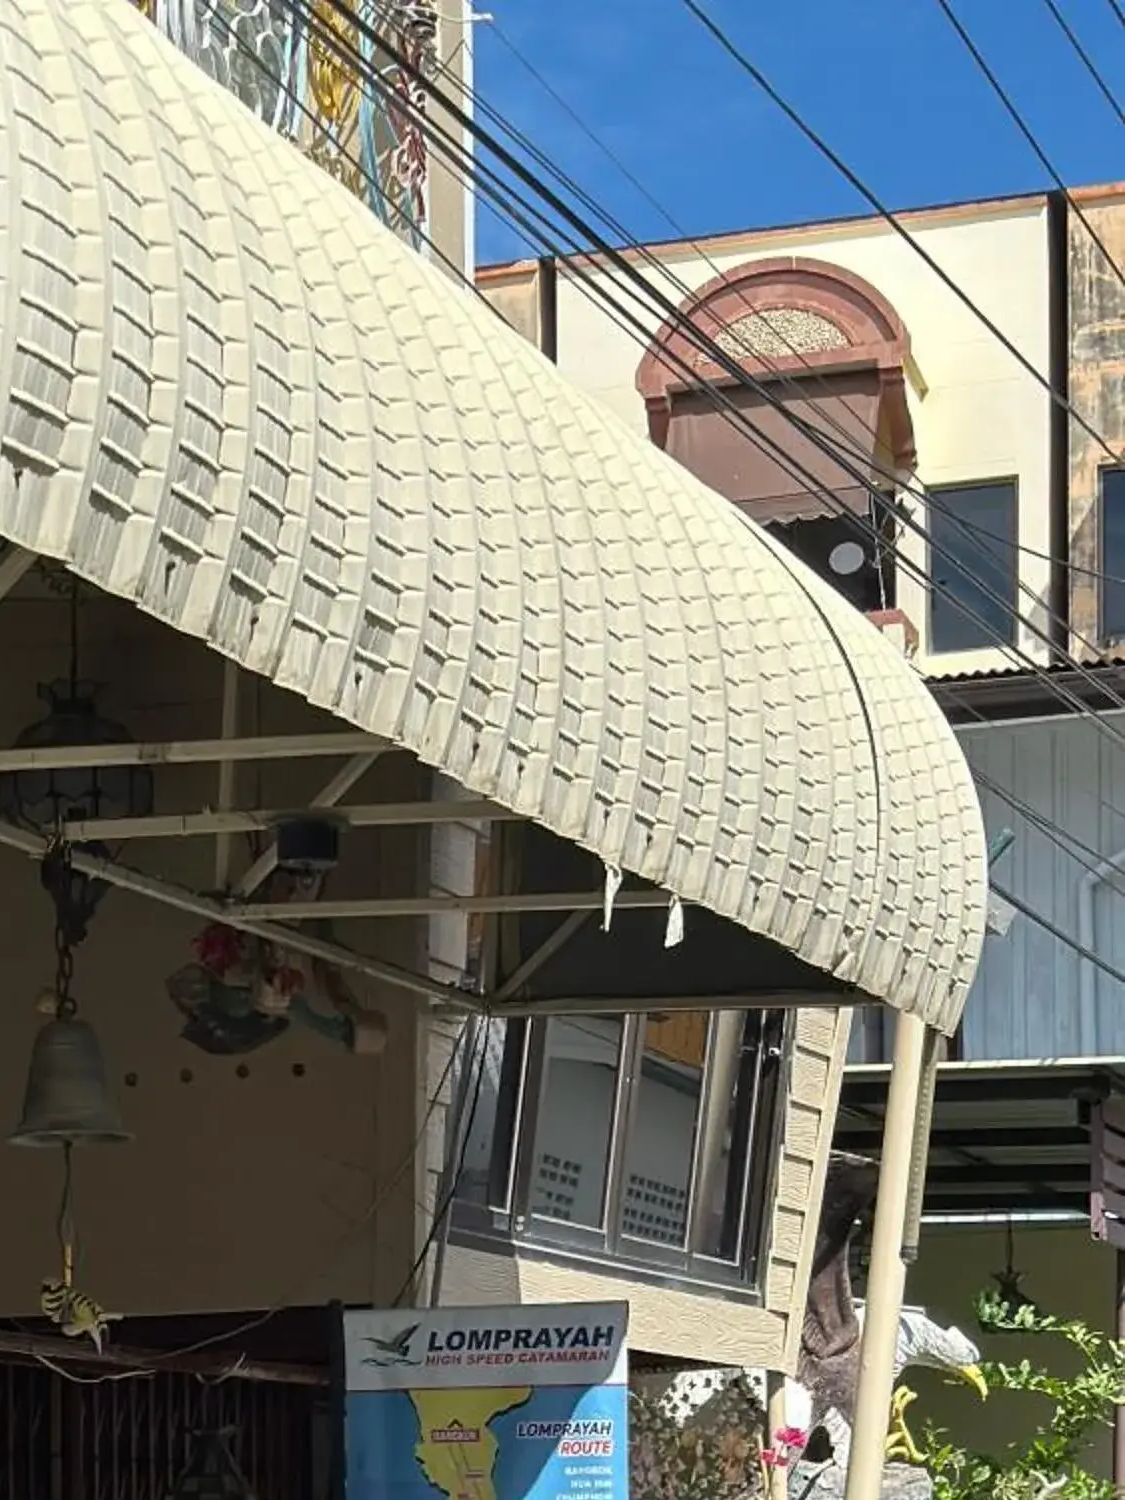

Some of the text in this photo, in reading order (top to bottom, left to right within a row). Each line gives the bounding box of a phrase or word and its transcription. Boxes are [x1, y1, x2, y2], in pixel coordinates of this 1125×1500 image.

[428, 1326, 613, 1351] LOMPRAYAH
[425, 1350, 611, 1366] HIGH SPEED CATAMARAN
[517, 1422, 612, 1438] LOMPRAYAH
[560, 1441, 611, 1454] ROUTE
